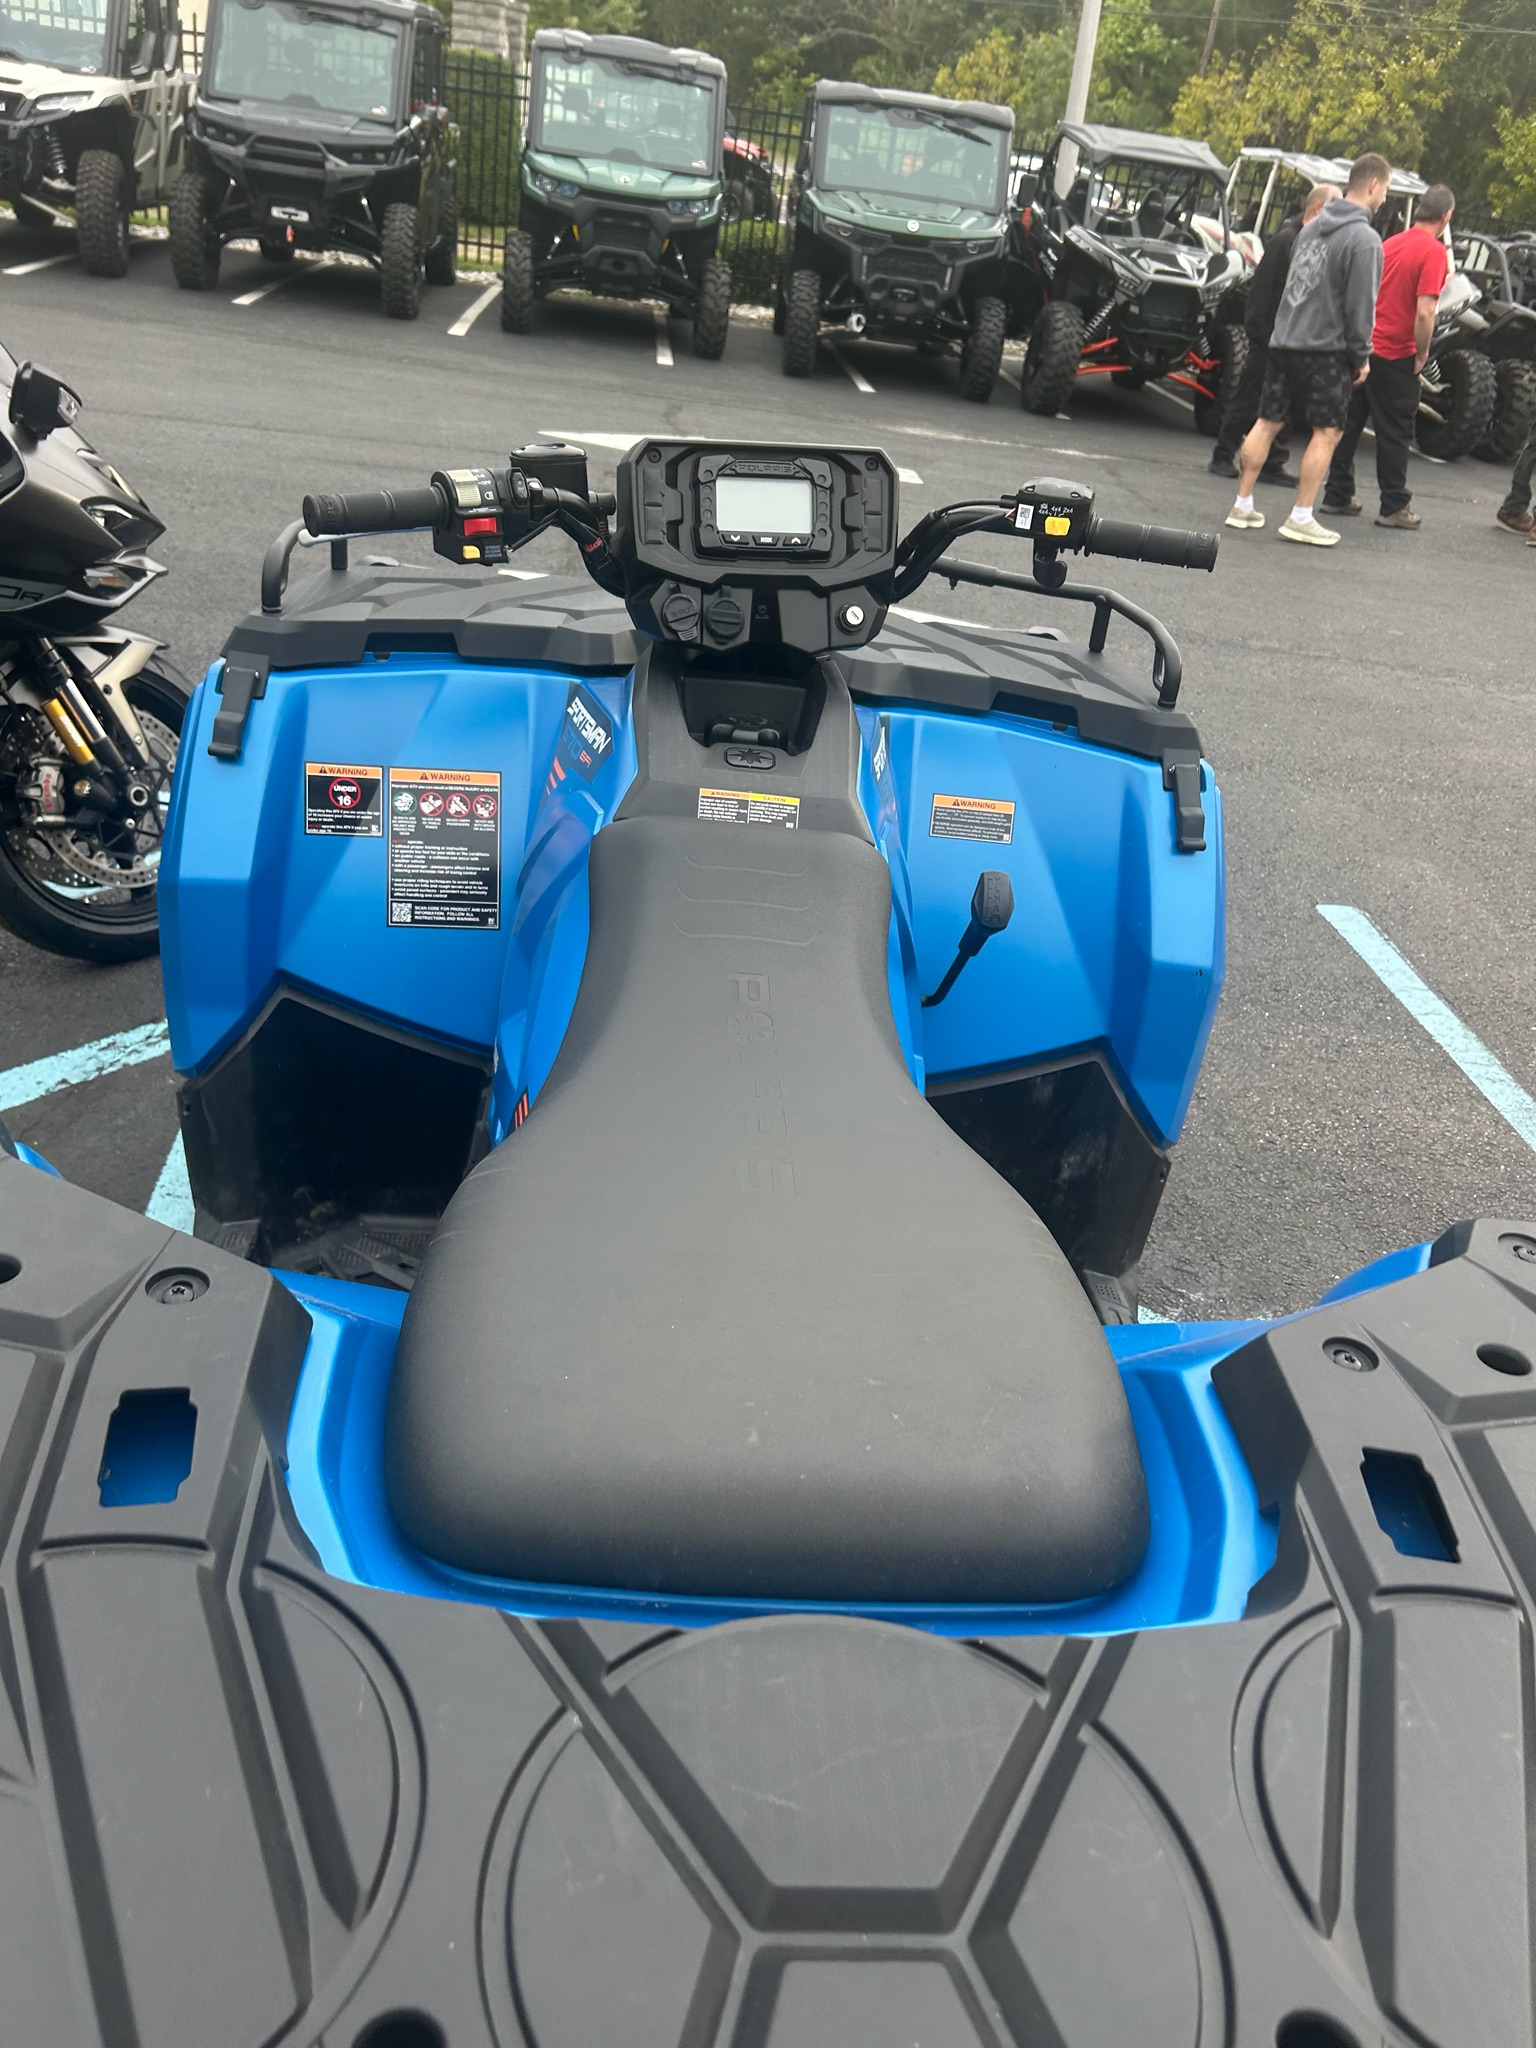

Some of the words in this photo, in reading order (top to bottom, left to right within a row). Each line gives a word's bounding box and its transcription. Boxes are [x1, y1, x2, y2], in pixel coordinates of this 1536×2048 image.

[738, 464, 792, 473] POLARIS
[566, 696, 612, 754] SPORTSMAN
[329, 768, 368, 776] WARNING
[430, 773, 471, 782] WARNING
[337, 796, 351, 806] 16
[960, 800, 996, 810] WARNING
